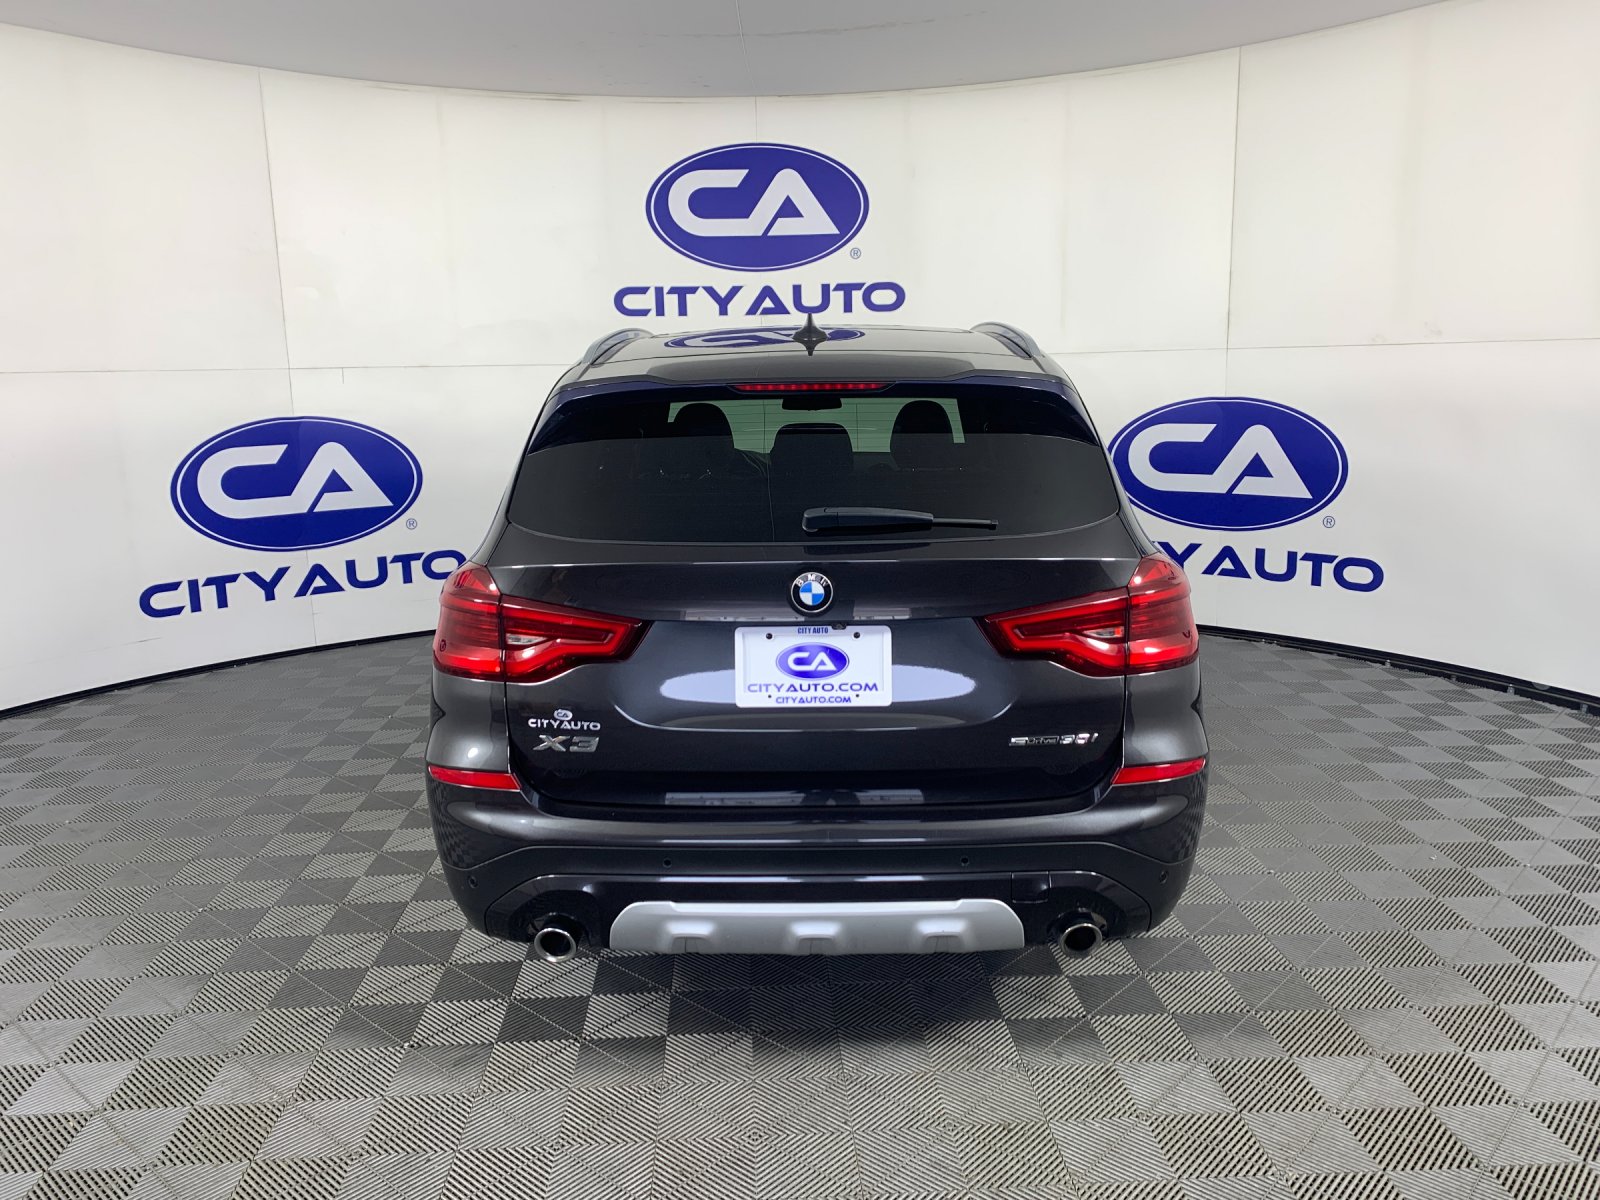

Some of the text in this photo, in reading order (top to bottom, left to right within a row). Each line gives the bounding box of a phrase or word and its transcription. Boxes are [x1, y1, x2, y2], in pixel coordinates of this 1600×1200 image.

[668, 168, 841, 237] CA
[1128, 423, 1313, 499] CA
[197, 441, 394, 519] CA
[795, 573, 829, 588] BMW
[797, 626, 829, 635] CITY AUTO
[787, 651, 838, 672] CA
[747, 682, 878, 693] CITYAUTO.COM
[775, 695, 852, 704] CITYAUTO.COM
[532, 734, 600, 753] X3
